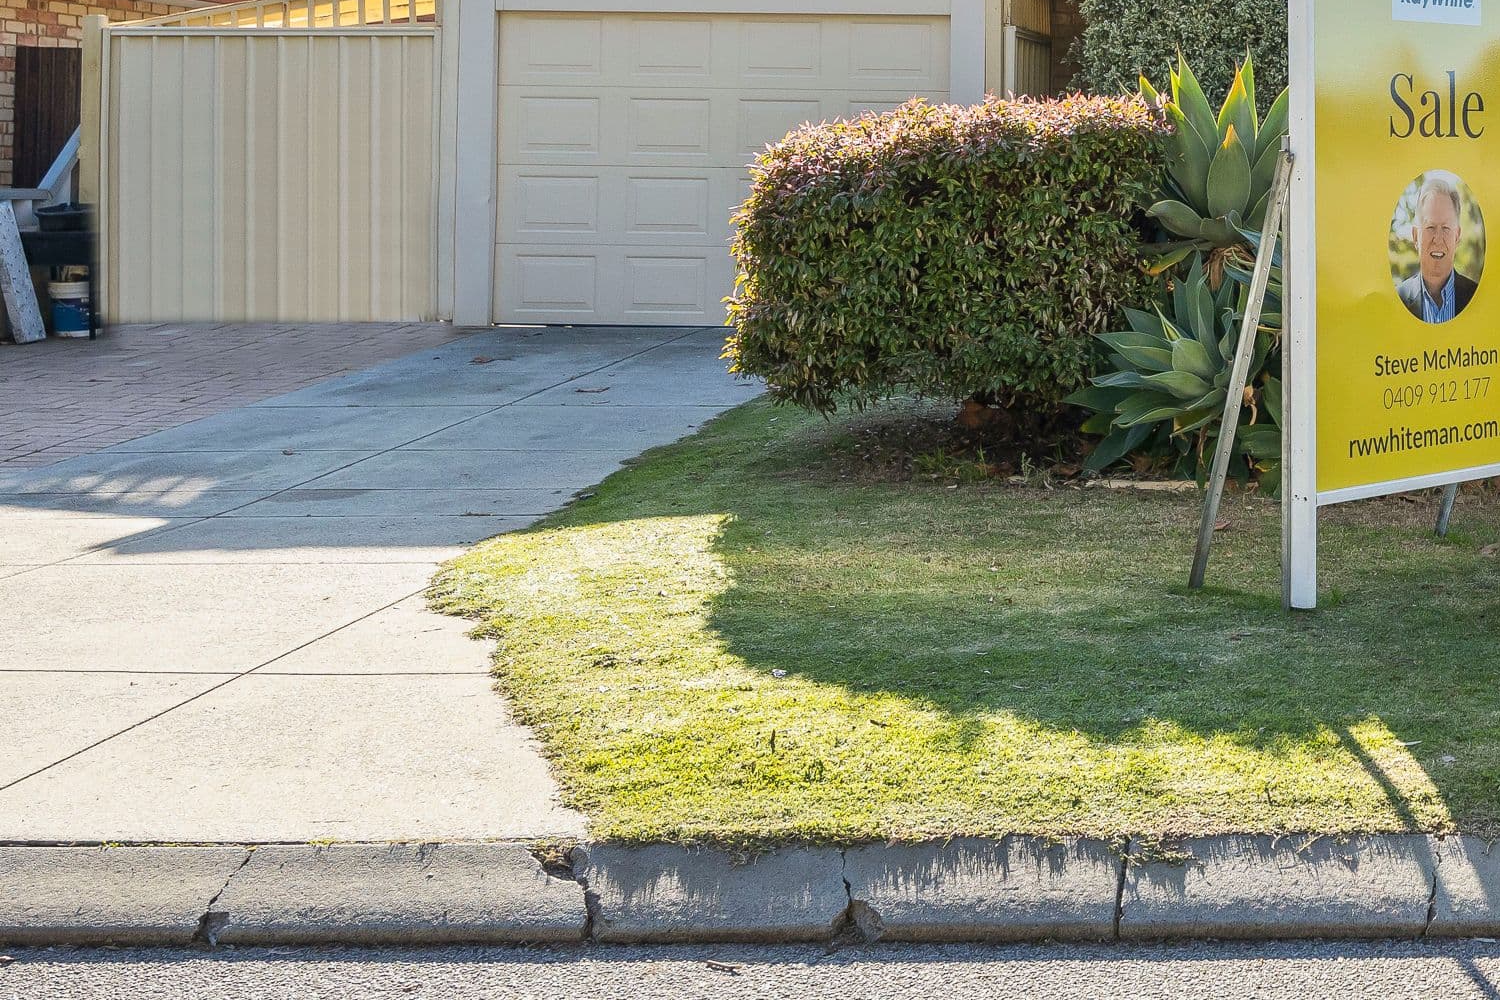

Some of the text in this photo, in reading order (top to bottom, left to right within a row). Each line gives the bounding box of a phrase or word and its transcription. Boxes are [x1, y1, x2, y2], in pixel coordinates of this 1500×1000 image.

[1389, 71, 1485, 139] Sale
[1374, 345, 1498, 377] Steve McMahon
[1383, 376, 1491, 410] 0409 912 177
